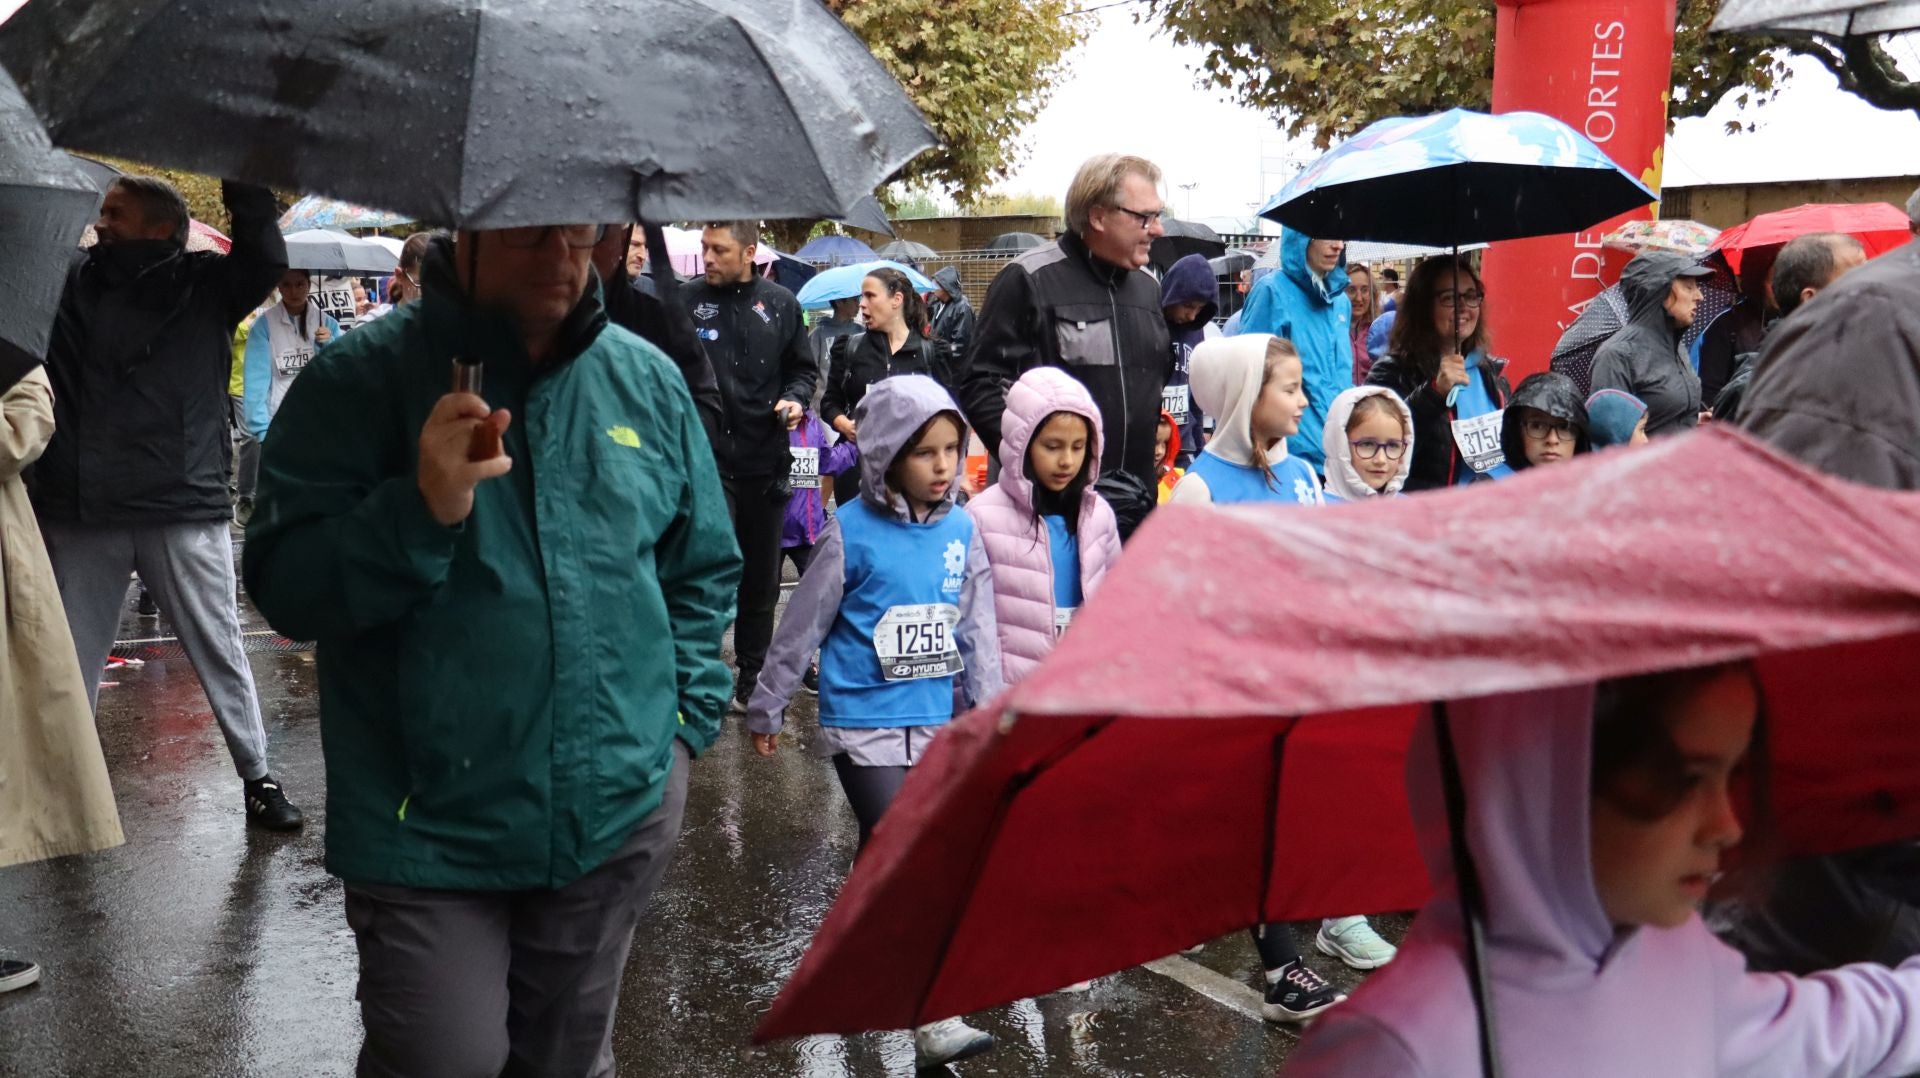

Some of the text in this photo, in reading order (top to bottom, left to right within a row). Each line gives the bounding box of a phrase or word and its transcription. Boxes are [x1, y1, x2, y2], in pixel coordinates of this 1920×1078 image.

[1584, 21, 1625, 143] ORTES
[1570, 232, 1604, 279] DE
[283, 353, 309, 368] 2279
[1163, 395, 1184, 412] 073
[792, 457, 815, 474] 333
[942, 577, 962, 588] AMP
[896, 622, 944, 654] 1259
[912, 662, 947, 674] HYUNDAI
